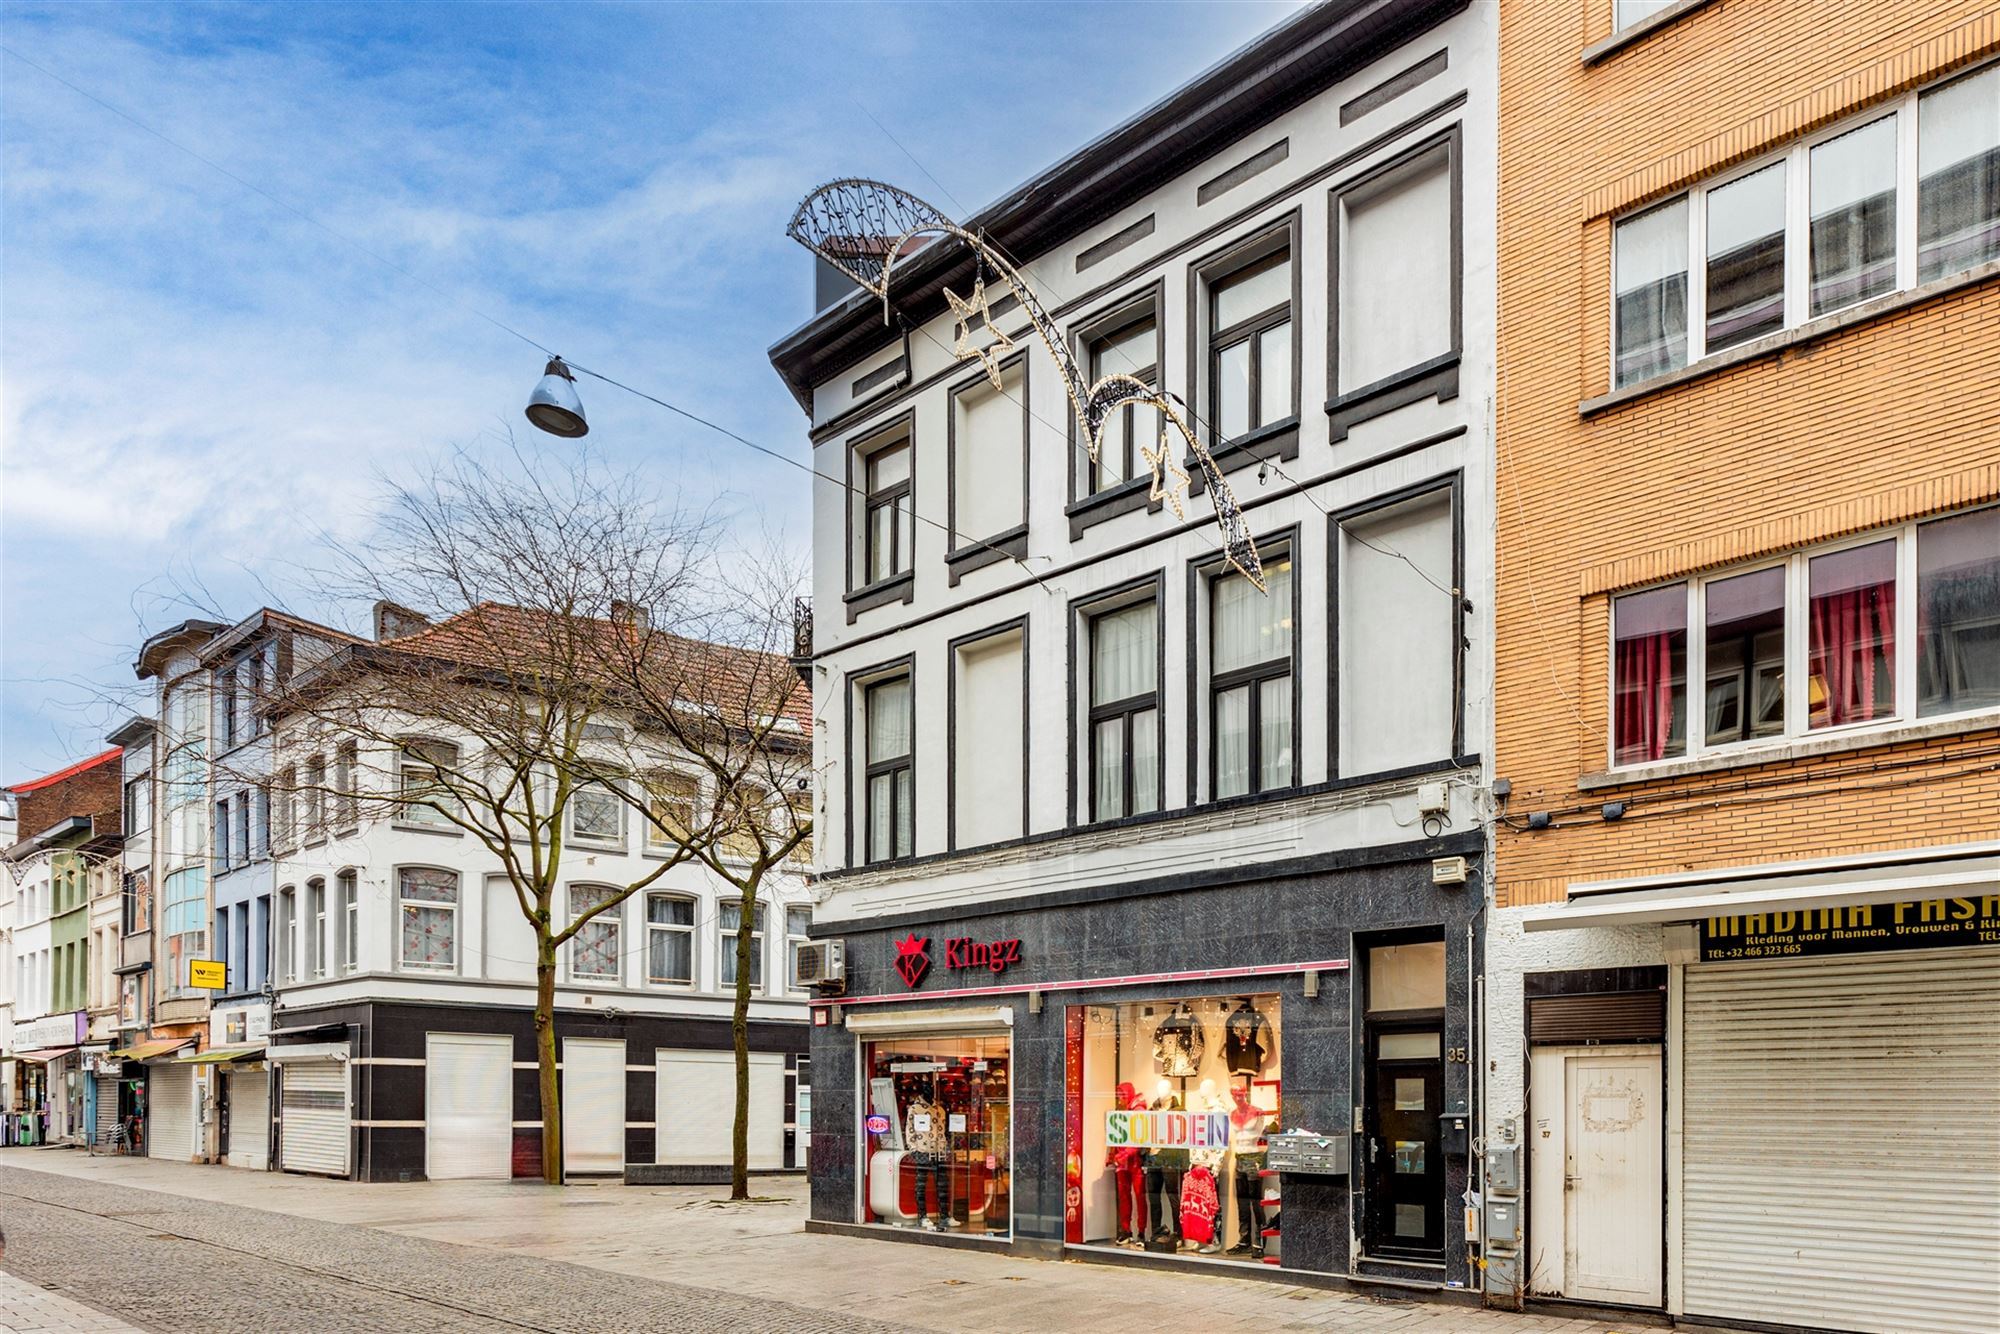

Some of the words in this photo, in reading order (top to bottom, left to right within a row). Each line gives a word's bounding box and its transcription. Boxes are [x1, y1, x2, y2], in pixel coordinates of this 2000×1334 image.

[1746, 934, 1794, 945] Kleding
[1798, 932, 1828, 942] voor
[1832, 927, 1891, 940] Mannen,
[944, 937, 1020, 972] Kingz
[1726, 947, 1743, 958] +32
[1744, 945, 1762, 957] 466
[1764, 944, 1781, 955] 323
[1783, 943, 1802, 954] 665
[1447, 1047, 1465, 1062] 35
[867, 1119, 888, 1130] OPEN
[1108, 1113, 1230, 1147] SOLDEN
[1542, 1131, 1551, 1139] 37
